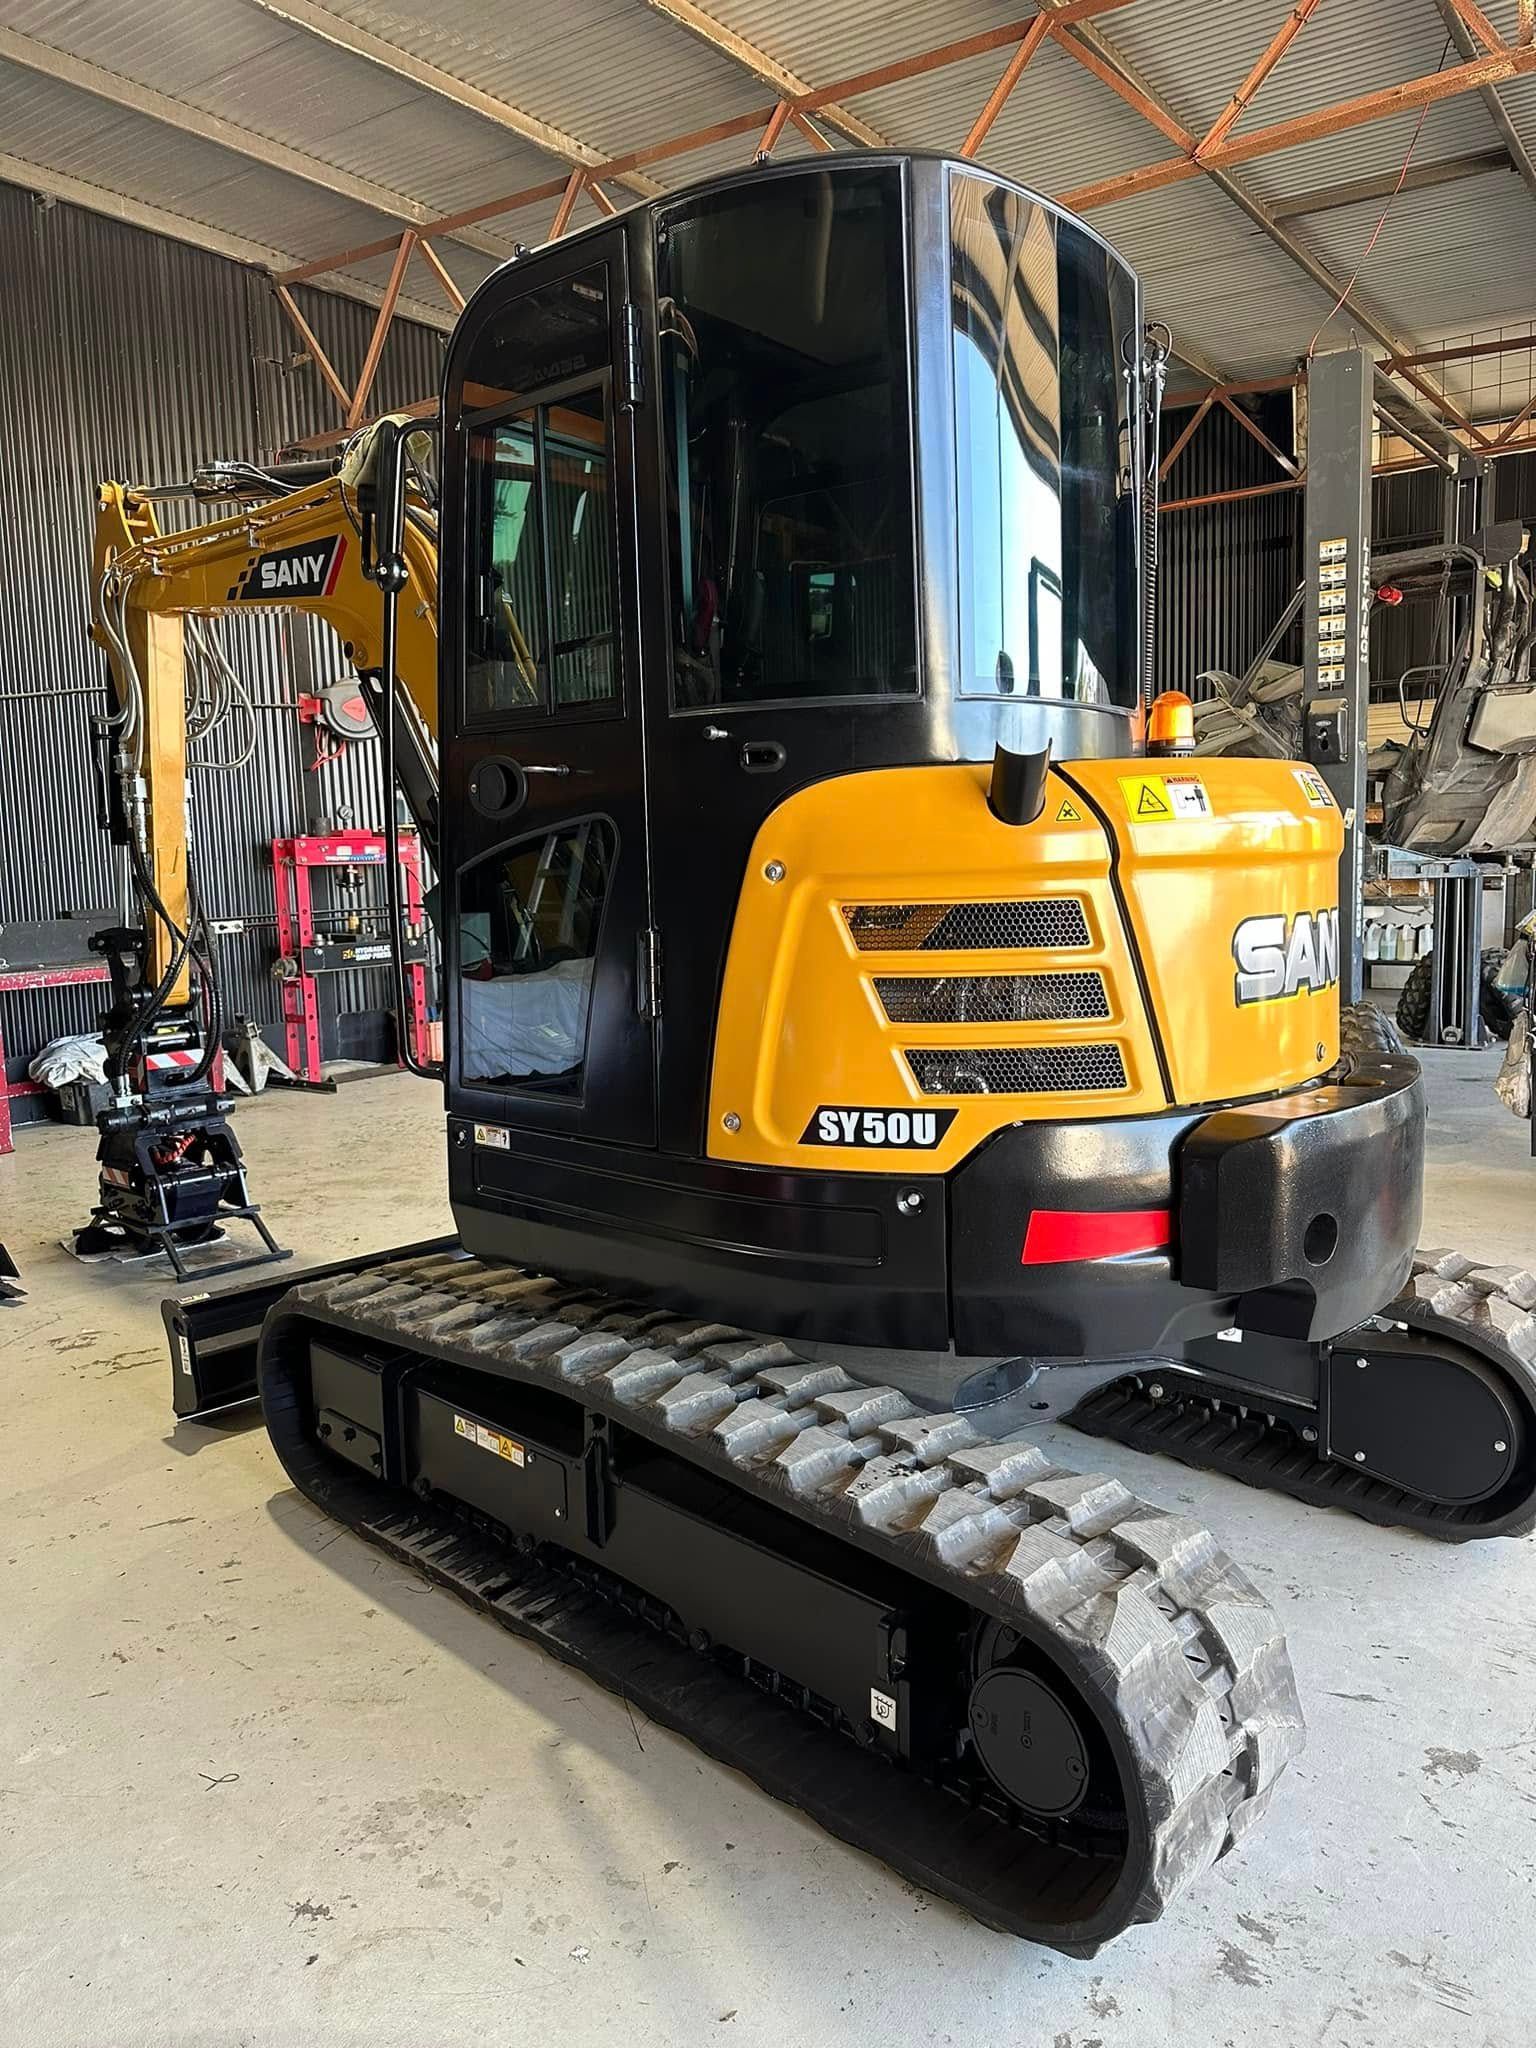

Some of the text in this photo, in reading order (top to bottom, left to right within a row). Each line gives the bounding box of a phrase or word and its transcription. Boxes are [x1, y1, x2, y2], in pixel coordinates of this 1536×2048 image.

[261, 554, 326, 589] SANY
[1360, 537, 1370, 653] LIFTKING
[1231, 906, 1339, 1008] SAN
[818, 1111, 936, 1145] SY50U
